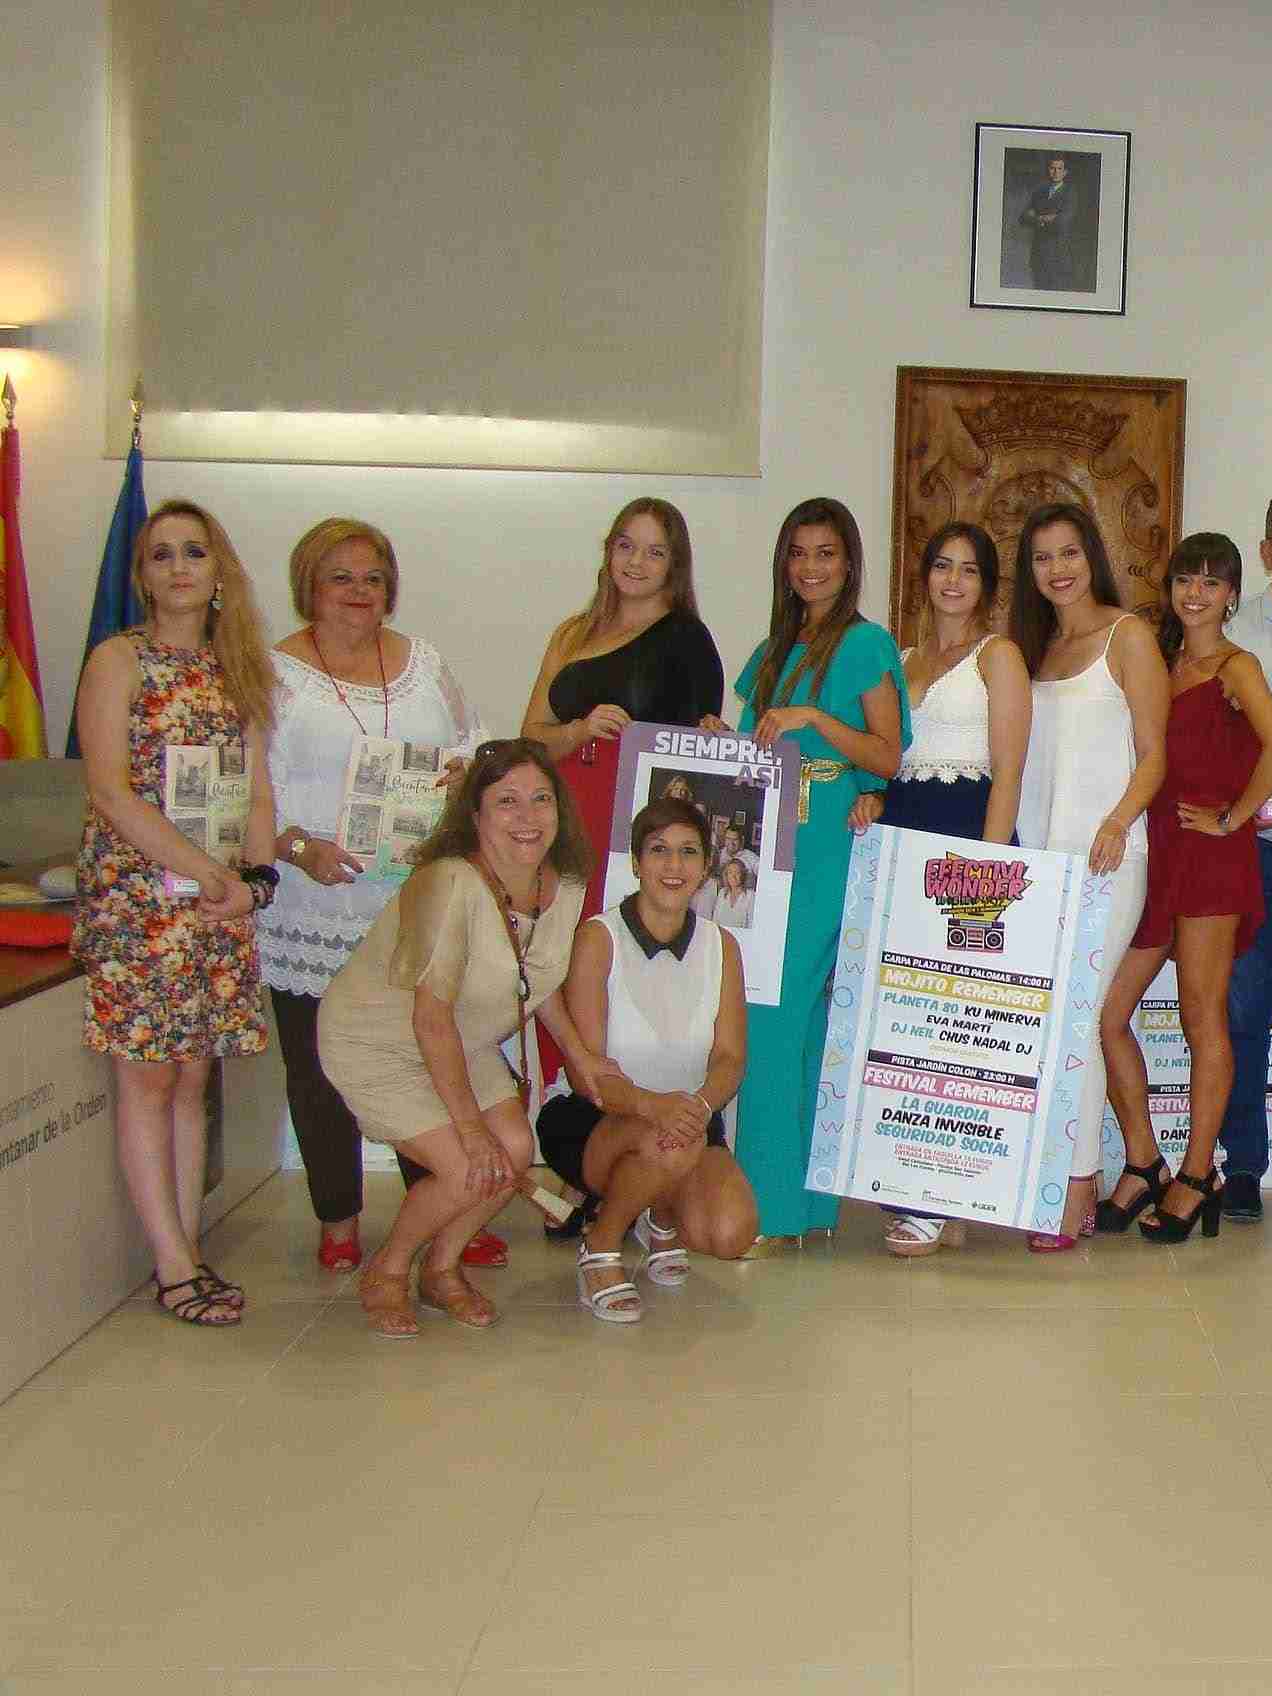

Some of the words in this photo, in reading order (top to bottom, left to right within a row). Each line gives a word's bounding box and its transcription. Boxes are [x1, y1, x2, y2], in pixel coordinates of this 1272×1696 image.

[654, 731, 773, 765] SIEMPRE
[925, 878, 1025, 899] WONDER
[884, 953, 911, 966] CARPA
[912, 957, 939, 970] PLAZA
[941, 961, 952, 972] DE
[953, 963, 970, 976] LAS
[971, 966, 1011, 982] PALOMAS
[1044, 979, 1051, 989] H
[884, 968, 948, 992] MOJITO
[883, 991, 939, 1012] PLANETA
[942, 1002, 960, 1014] 80
[964, 1005, 982, 1018] KU
[984, 1008, 1041, 1028] MINERVA
[926, 1014, 950, 1027] EVA
[952, 1019, 994, 1034] MARTÍ
[890, 1022, 908, 1034] DJ
[910, 1026, 936, 1039] NEIL
[938, 1030, 970, 1045] CHUS
[972, 1037, 1012, 1053] NADAL
[1015, 1042, 1033, 1056] DJ
[1145, 1033, 1184, 1044] PLANET
[891, 1055, 916, 1067] PISTA
[949, 1065, 978, 1078] COLON
[1008, 1075, 1016, 1084] H
[864, 1066, 938, 1094] FESTIVAL
[942, 1079, 1036, 1110] REMEMBER
[882, 1108, 930, 1128] DANZA
[934, 1118, 1005, 1140] INVISIBLE
[900, 1096, 920, 1111] LA
[924, 1100, 990, 1123] GUARDIA
[874, 1122, 957, 1148] SEGURIDAD
[959, 1134, 1010, 1158] SOCIAL
